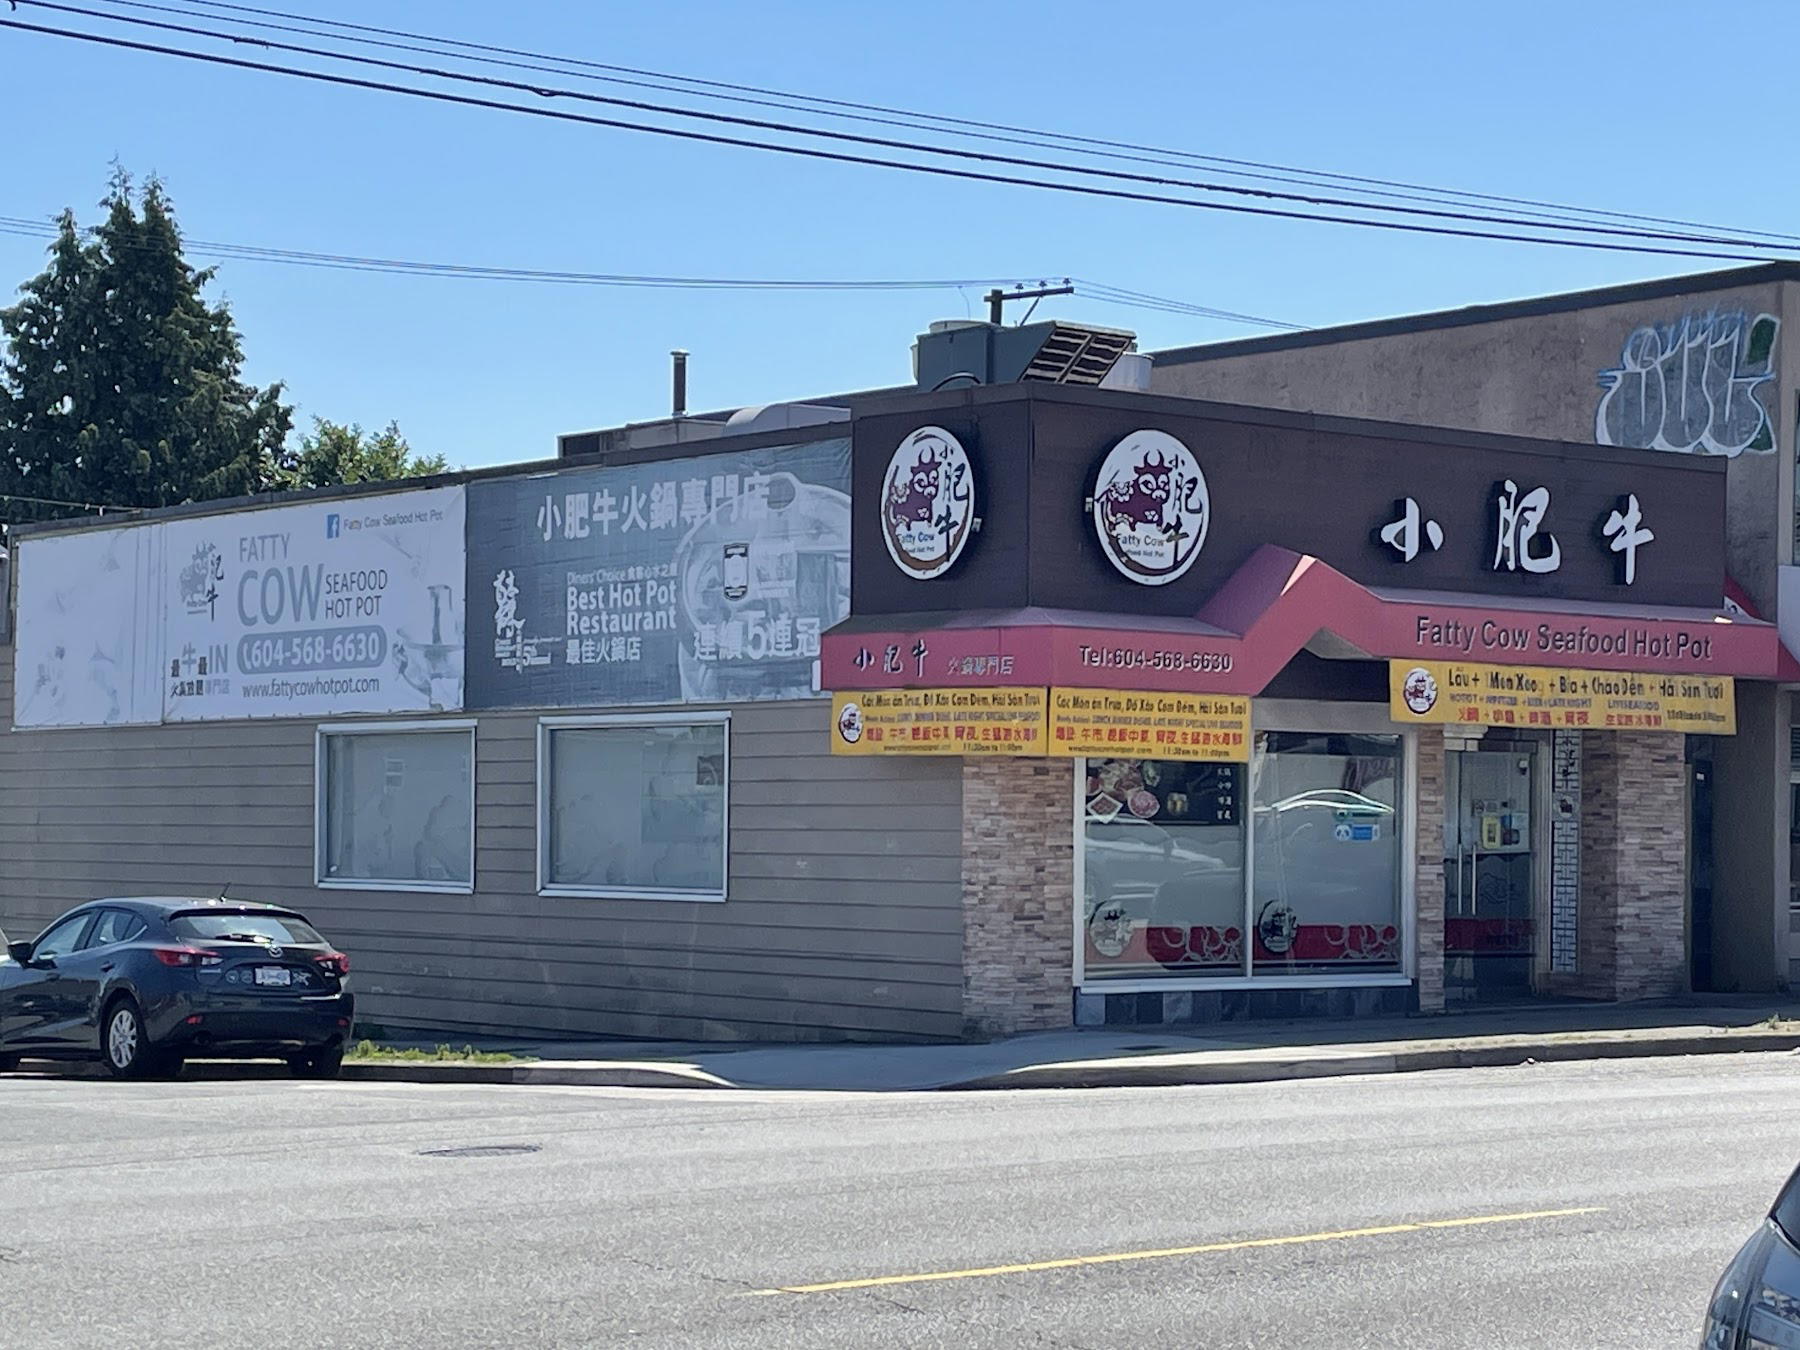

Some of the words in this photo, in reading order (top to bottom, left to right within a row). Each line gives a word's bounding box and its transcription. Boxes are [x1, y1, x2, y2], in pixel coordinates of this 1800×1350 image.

[240, 533, 290, 562] FATTY
[1381, 480, 1655, 585] 小肥牛
[238, 563, 324, 626] COW
[326, 569, 388, 594] SEAFOOD
[567, 586, 605, 611] Best
[609, 583, 641, 608] Hot
[646, 580, 677, 605] Pot
[326, 598, 352, 619] HOT
[356, 595, 382, 617] POT
[567, 605, 677, 635] Restaurant
[1416, 615, 1475, 653] Fatty
[1481, 620, 1531, 650] Cow
[1537, 624, 1628, 657] Seafood
[1633, 630, 1672, 658] Hot
[1675, 632, 1713, 661] Pot
[242, 677, 380, 700] www.fattycowhotpot.com
